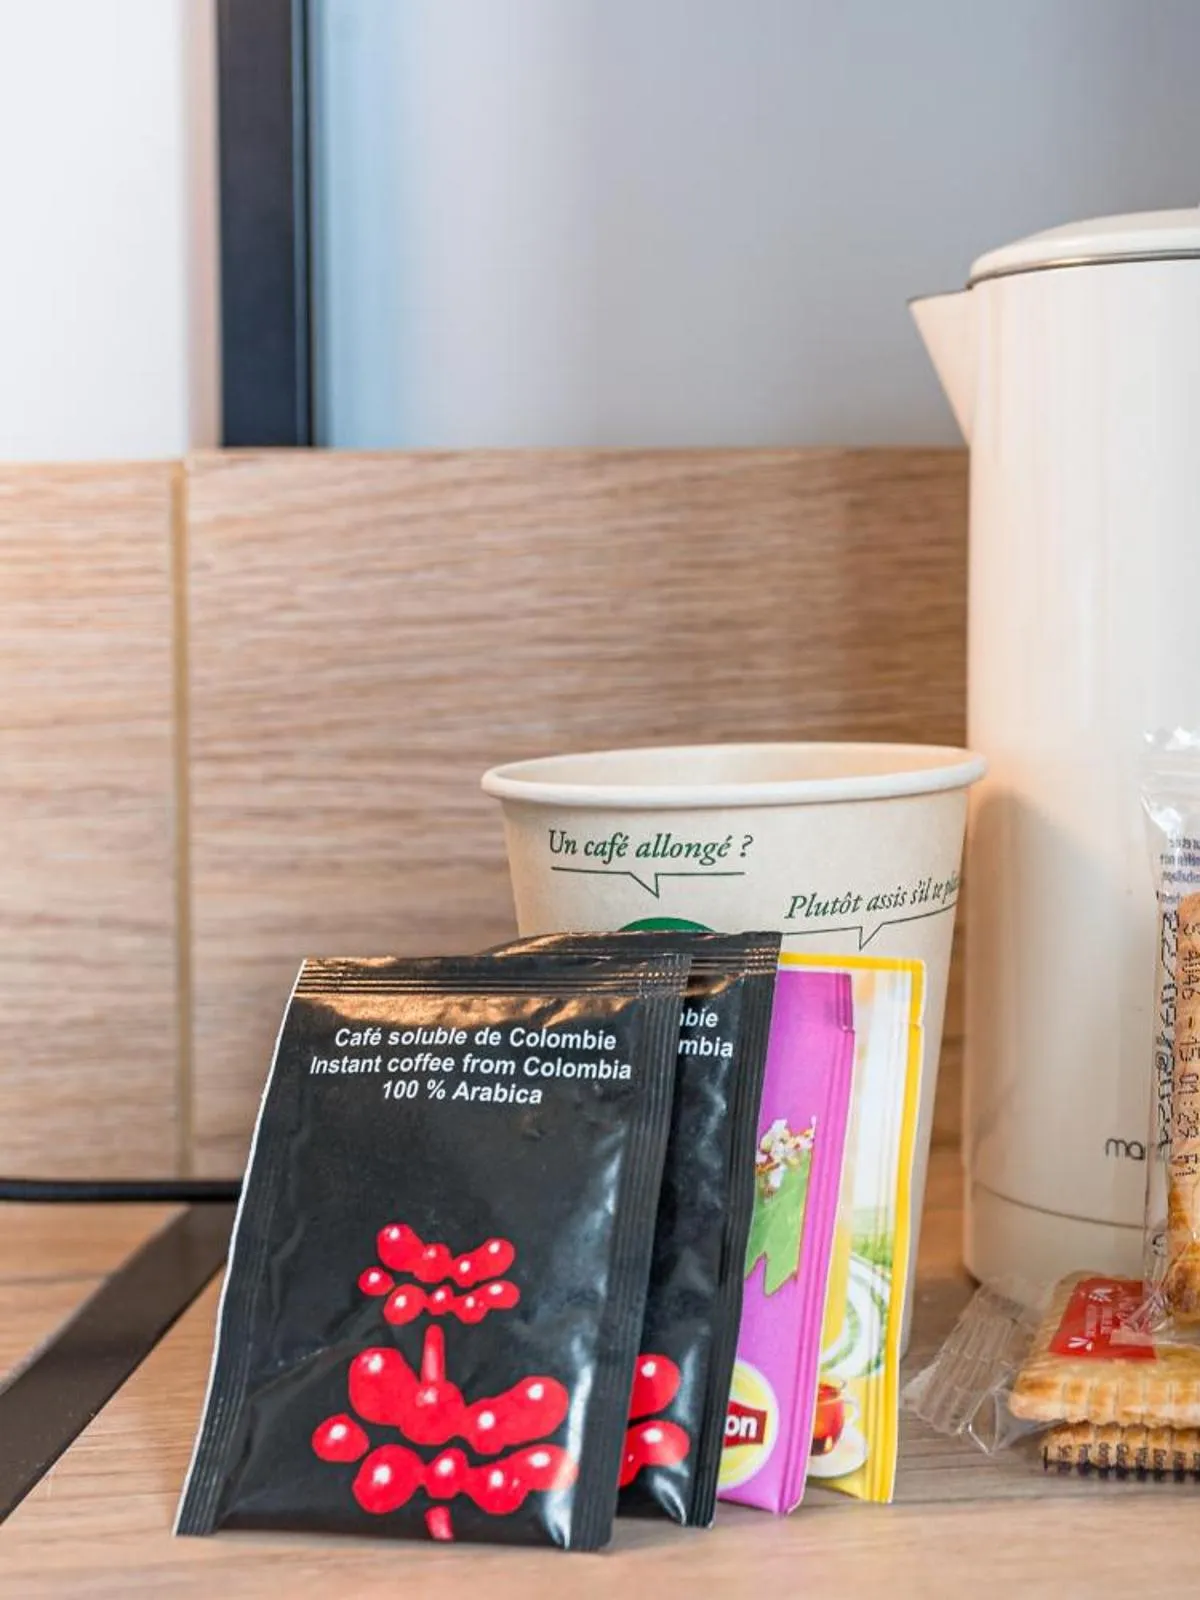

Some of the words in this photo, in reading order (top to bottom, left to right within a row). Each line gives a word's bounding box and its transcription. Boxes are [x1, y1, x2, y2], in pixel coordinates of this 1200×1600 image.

[548, 829, 577, 855] Un
[584, 832, 629, 864] café
[635, 833, 733, 866] allongé
[784, 893, 861, 920] Plutôt
[867, 885, 908, 911] assis
[679, 1007, 718, 1028] bie
[334, 1027, 382, 1047] Café
[387, 1027, 467, 1046] soluble
[474, 1028, 502, 1047] de
[508, 1027, 617, 1051] Colombie
[678, 1036, 733, 1058] mbia
[309, 1055, 382, 1075] Instant
[386, 1054, 455, 1074] coffee
[462, 1055, 516, 1076] from
[523, 1057, 632, 1081] Colombia
[381, 1080, 419, 1100] 100
[426, 1081, 447, 1101] %
[451, 1082, 543, 1105] Arabica
[1105, 1137, 1146, 1160] ma
[724, 1415, 757, 1438] on
